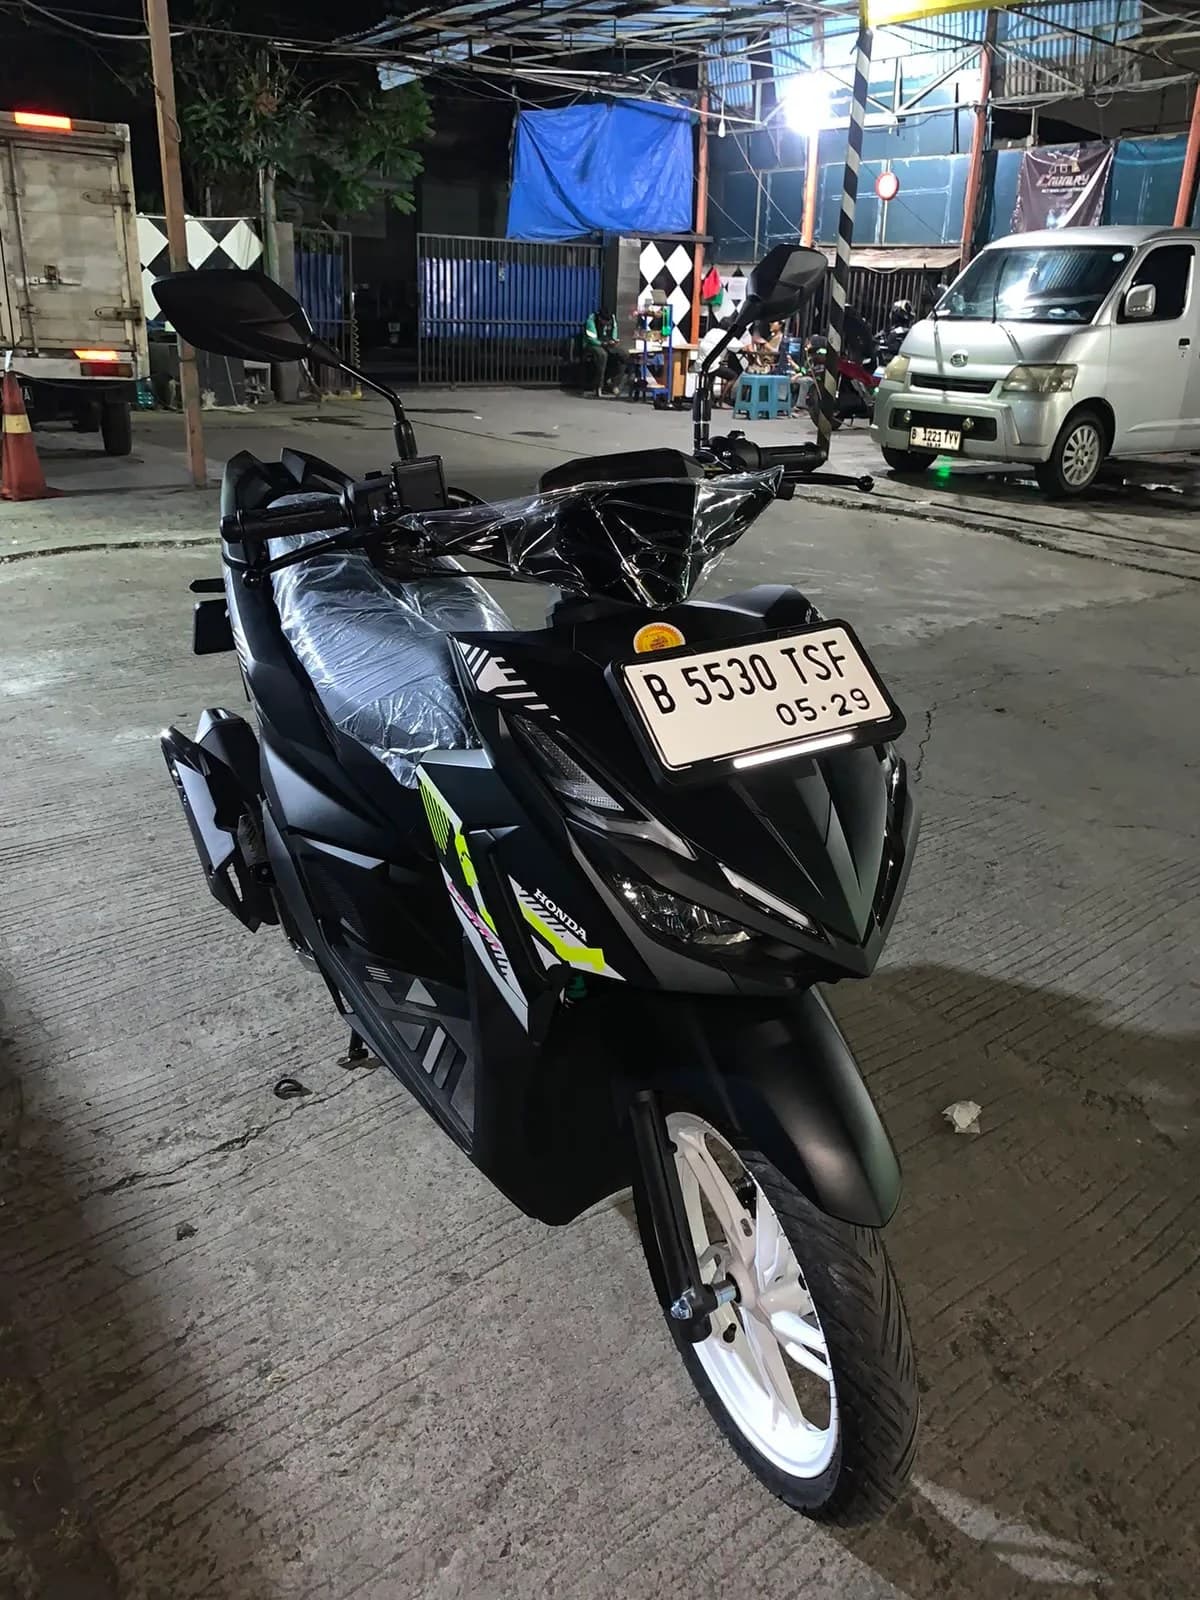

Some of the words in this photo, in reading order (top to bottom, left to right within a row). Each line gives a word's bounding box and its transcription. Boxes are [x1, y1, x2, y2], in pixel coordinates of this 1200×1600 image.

[911, 428, 917, 439] B
[644, 674, 676, 714] B
[681, 654, 777, 705] 5530
[780, 641, 846, 684] TSF
[535, 889, 588, 943] HONDA
